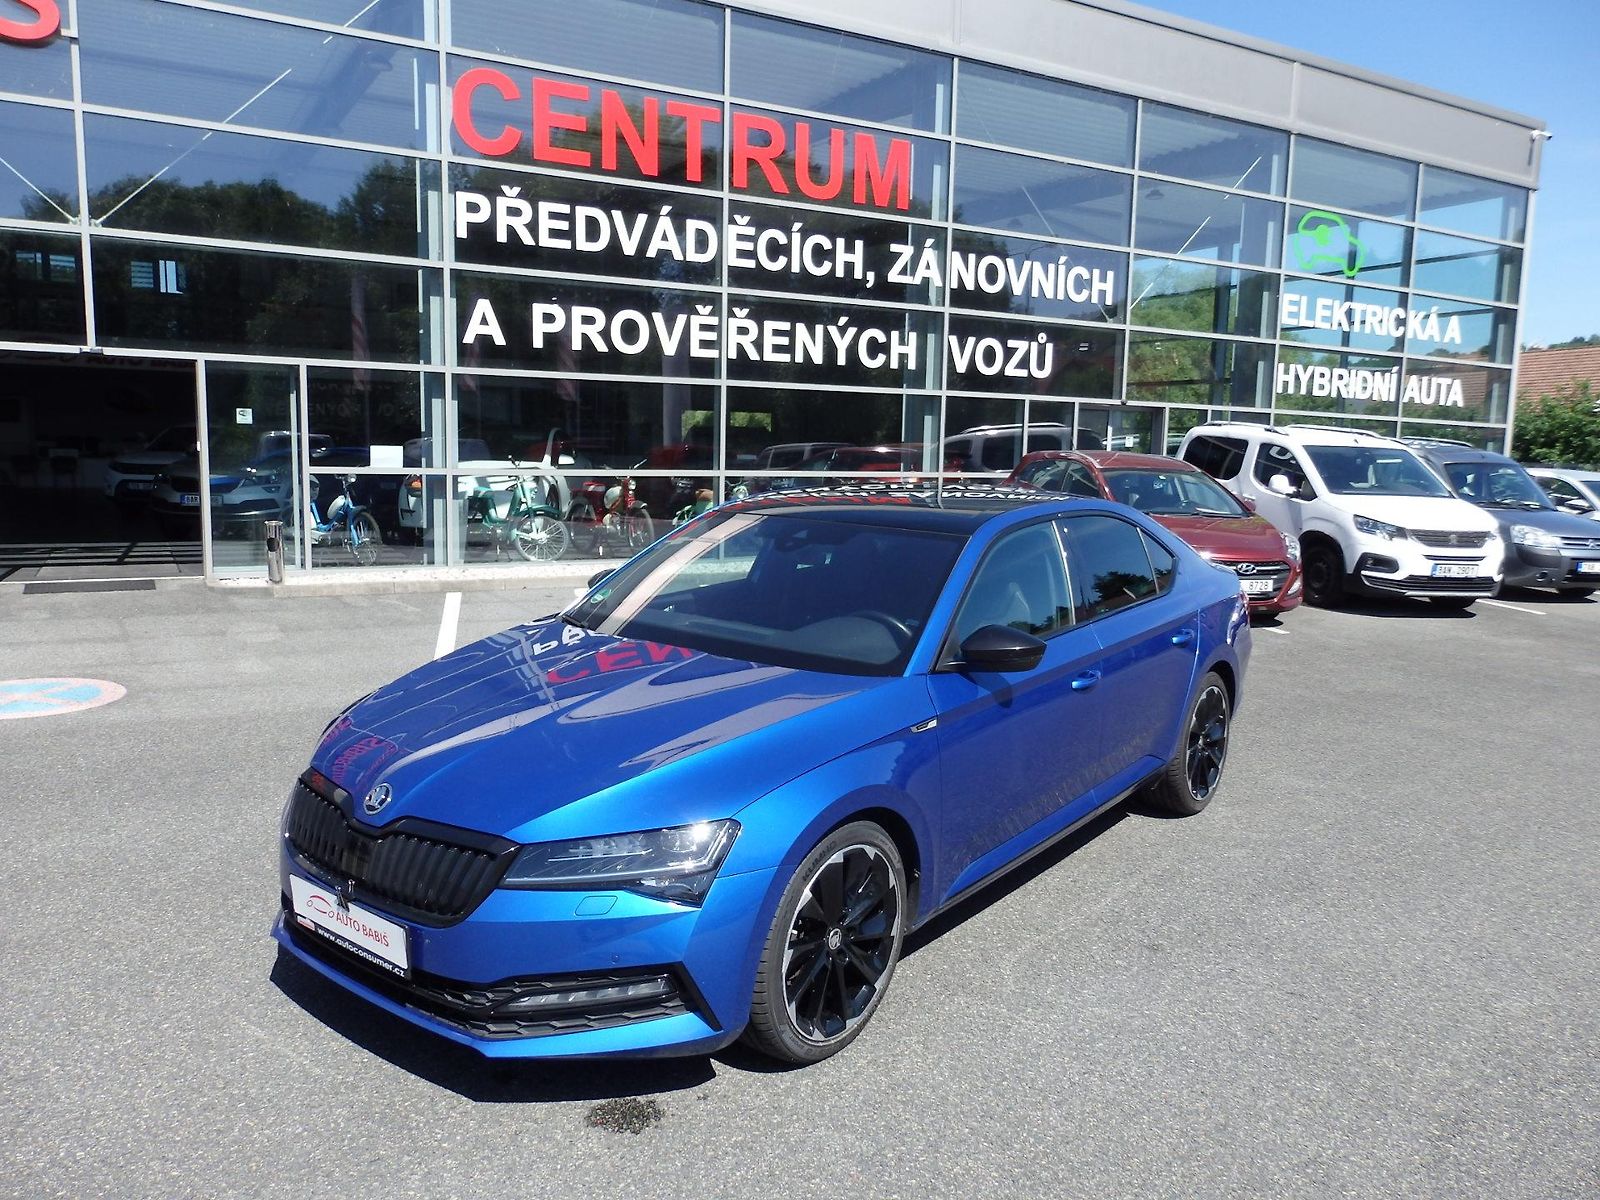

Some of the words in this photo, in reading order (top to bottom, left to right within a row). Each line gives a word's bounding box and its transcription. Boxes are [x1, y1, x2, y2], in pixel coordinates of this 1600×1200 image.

[452, 67, 912, 210] CENTRUM
[454, 185, 875, 288] PŘEDVÁDĚCÍCH,
[462, 298, 507, 346] A
[531, 303, 917, 371] PROVĚŘENÝCH
[948, 332, 1054, 379] VOZŮ
[1281, 293, 1440, 343] ELEKTRICKÁ
[1443, 315, 1462, 345] A
[1276, 362, 1400, 403] HYBRIDNÍ
[1402, 374, 1465, 408] AUTA
[336, 912, 361, 932] AUTO
[317, 927, 405, 978] www.autoconsumer.cz
